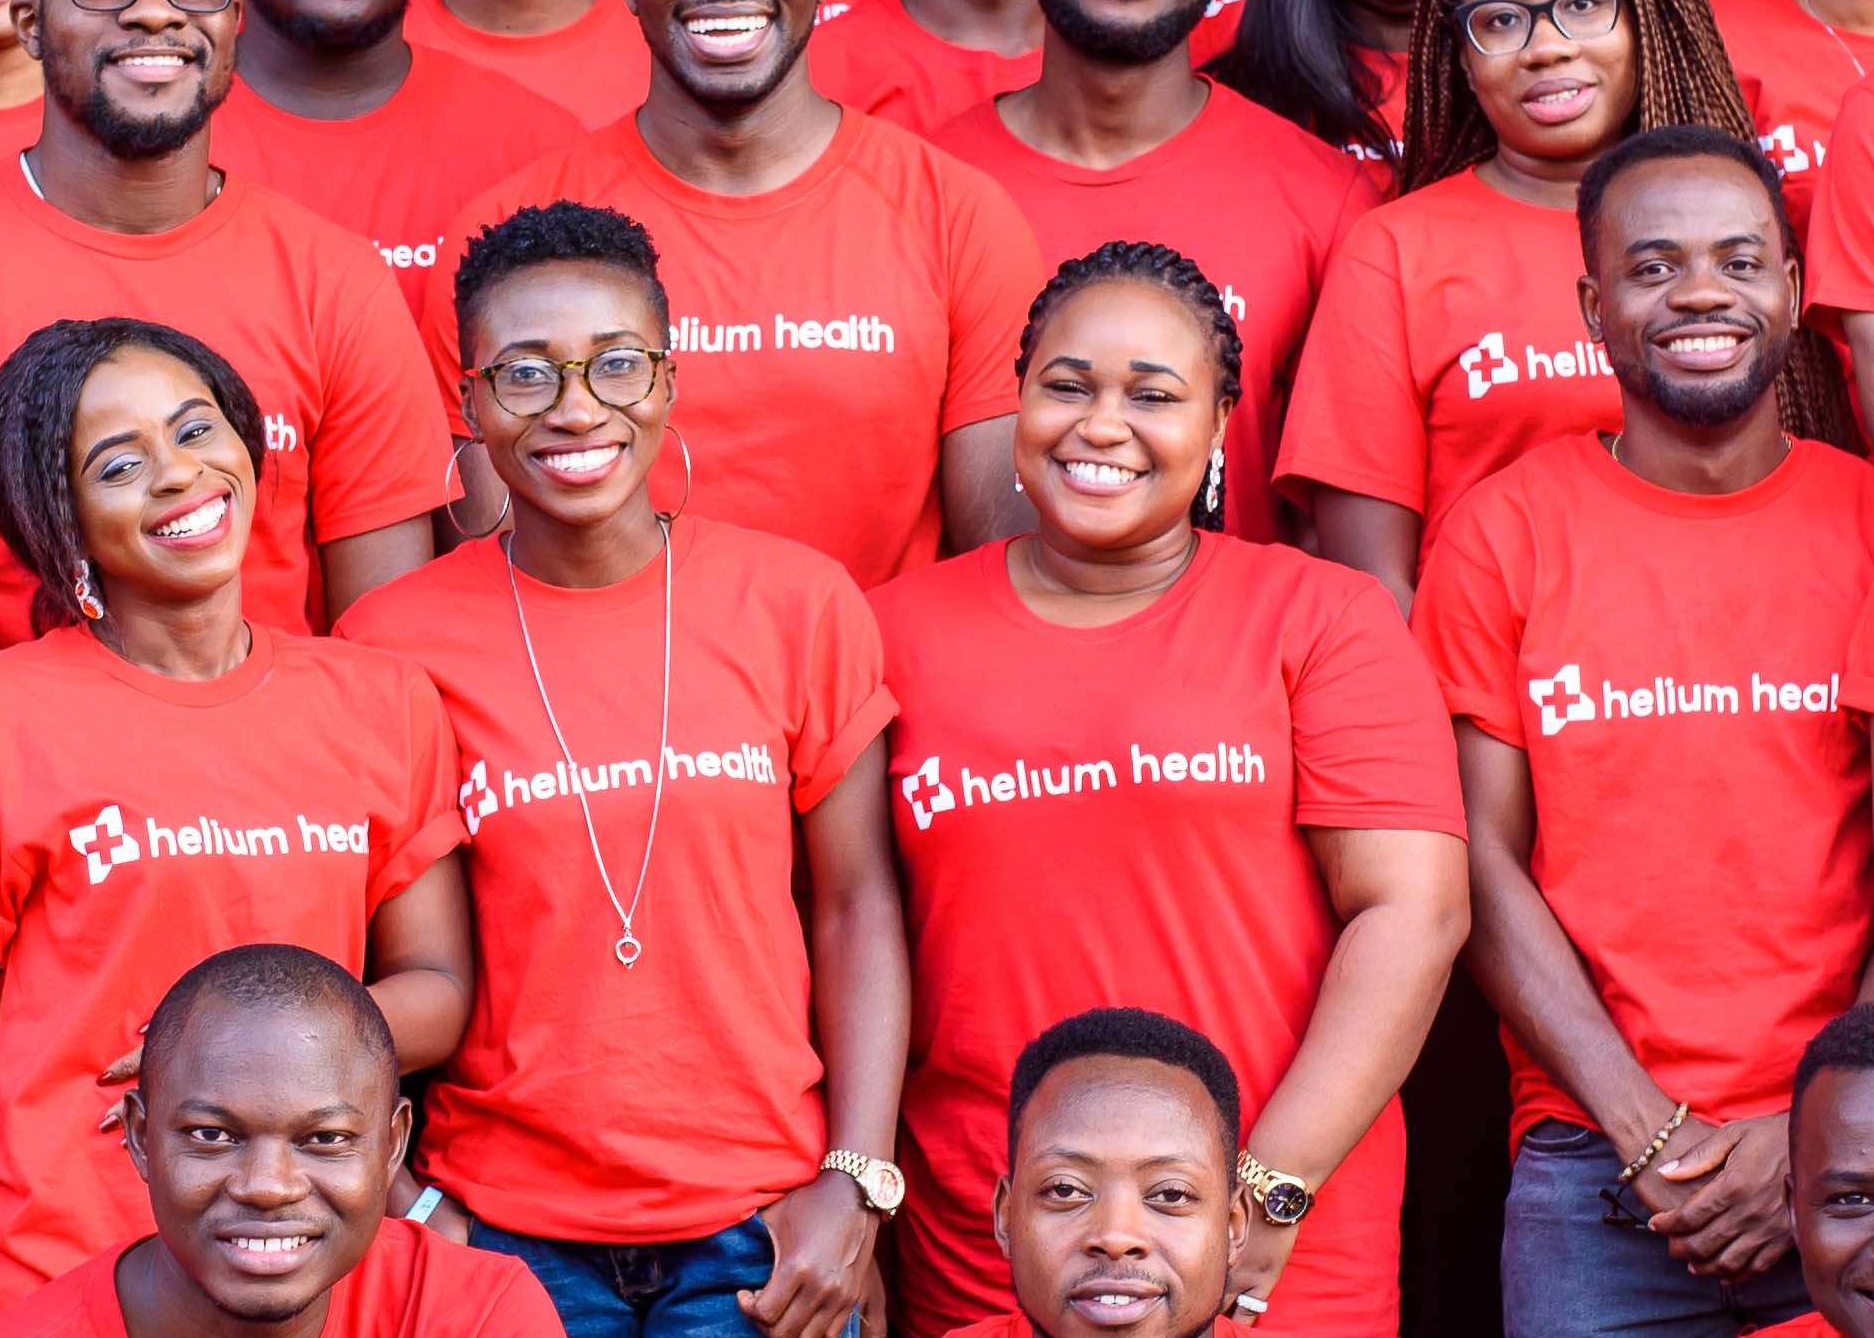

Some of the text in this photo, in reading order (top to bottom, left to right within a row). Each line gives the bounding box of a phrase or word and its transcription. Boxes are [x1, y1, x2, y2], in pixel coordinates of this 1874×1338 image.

[668, 313, 895, 354] elium health
[1525, 339, 1616, 381] heliu
[1602, 672, 1840, 721] helium heal
[502, 741, 778, 809] helium health
[960, 742, 1266, 808] helium health
[145, 813, 370, 859] helium hea
